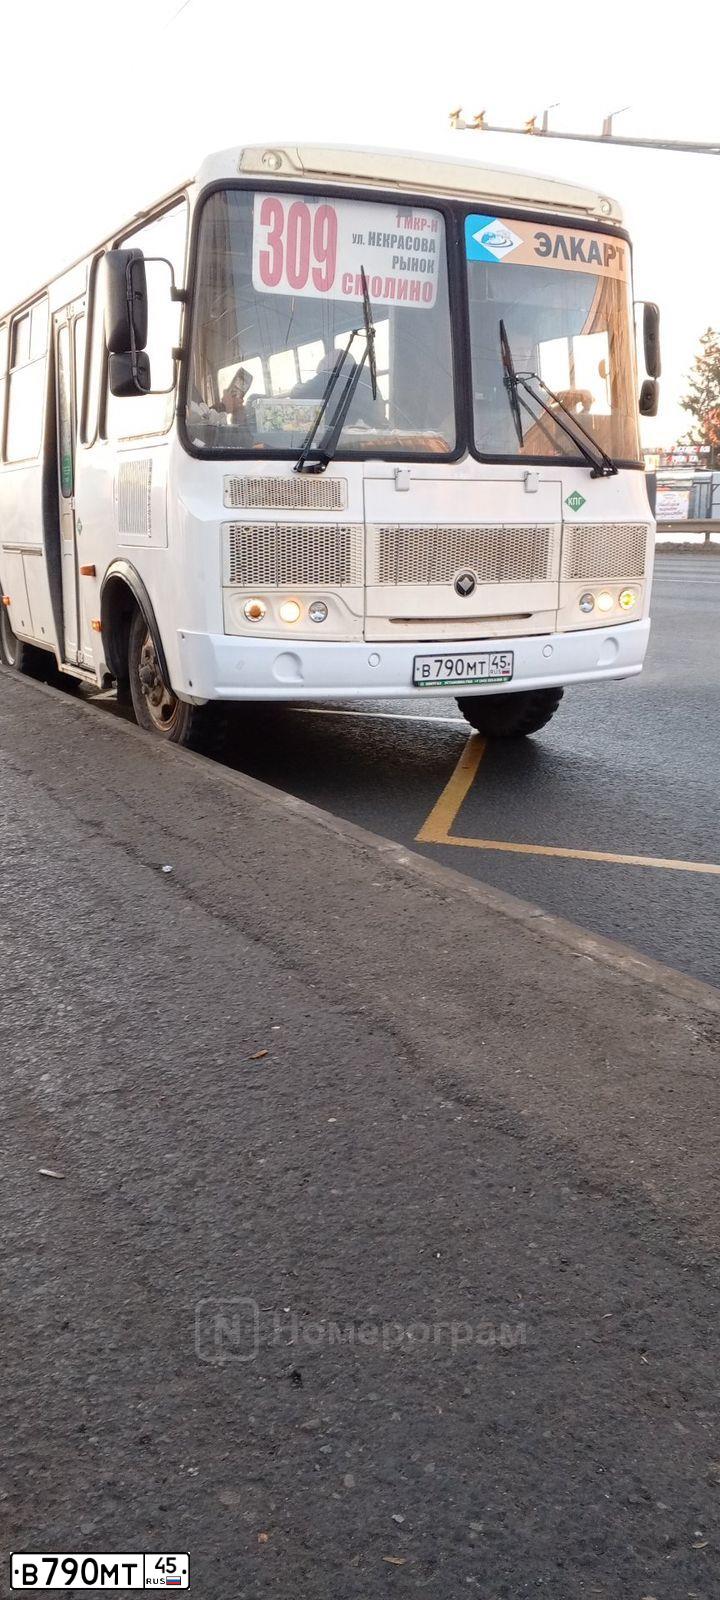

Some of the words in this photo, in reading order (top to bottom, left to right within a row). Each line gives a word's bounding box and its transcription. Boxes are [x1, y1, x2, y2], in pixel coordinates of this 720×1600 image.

[396, 215, 403, 228] 1
[404, 216, 438, 233] МКР-Н
[259, 197, 338, 292] 309
[368, 231, 436, 253] НЕКРАСОВА
[533, 232, 625, 271] ЭЛКАРТ
[392, 256, 434, 274] РЫНОК
[341, 273, 433, 303] СМОЛИНО
[422, 658, 486, 678] В790МТ
[491, 655, 507, 669] 45
